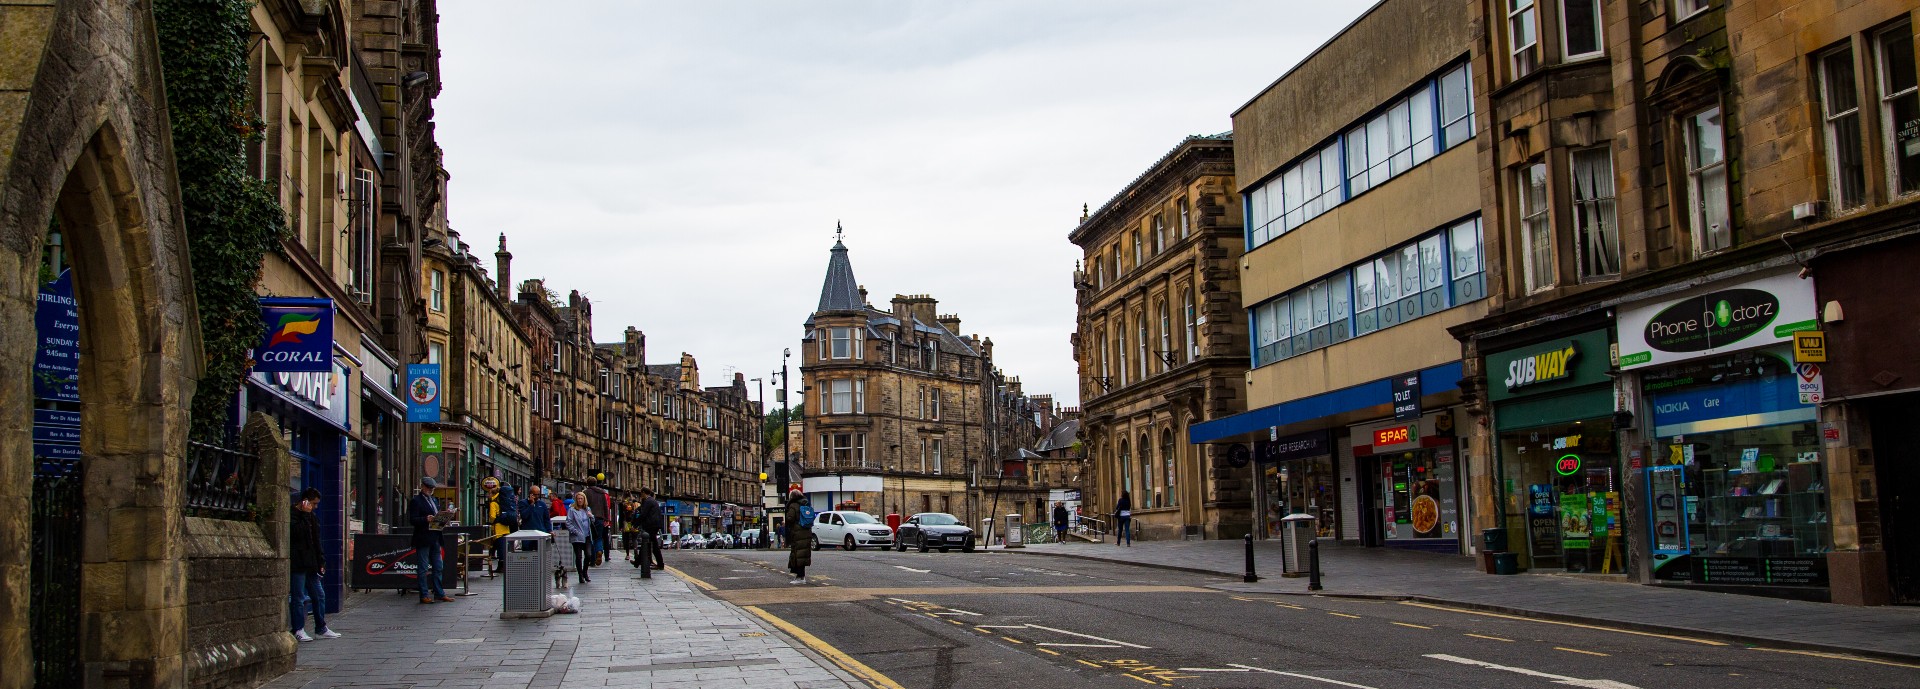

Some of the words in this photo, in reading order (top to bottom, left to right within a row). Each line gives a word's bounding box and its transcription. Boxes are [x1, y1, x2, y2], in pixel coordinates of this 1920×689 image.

[1651, 319, 1698, 339] Phone
[1704, 300, 1773, 329] Doctorz
[46, 337, 74, 347] SUNDAY
[262, 351, 324, 363] CORAL
[1505, 346, 1575, 389] SUBWAY
[1800, 383, 1819, 392] epay
[1394, 392, 1402, 402] TO
[1402, 390, 1411, 401] LET
[1656, 401, 1690, 415] NOKIA
[1704, 398, 1720, 408] Care
[1380, 427, 1408, 443] SPAR
[1288, 439, 1311, 452] RESEARCH
[1553, 433, 1582, 450] SUBWAY
[1560, 459, 1579, 471] OPEN
[1593, 496, 1604, 506] Sub
[1593, 506, 1605, 515] Day
[1534, 518, 1554, 527] OPEN
[1534, 526, 1557, 534] UNTIL
